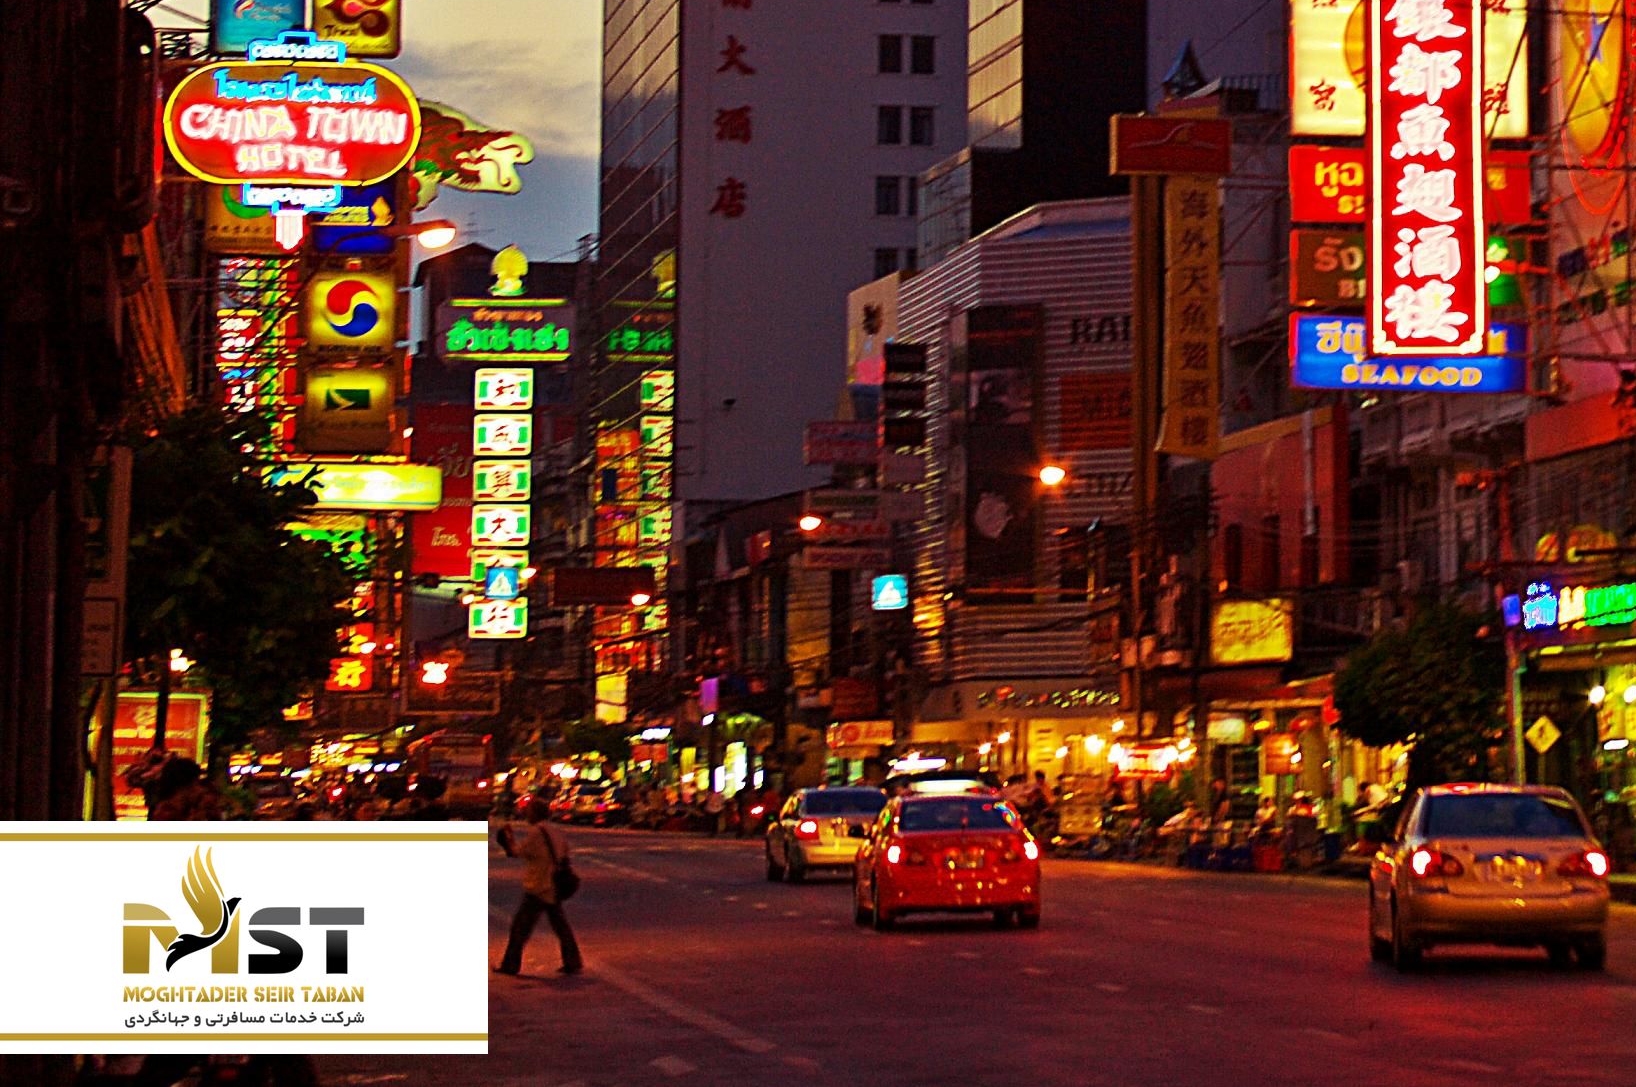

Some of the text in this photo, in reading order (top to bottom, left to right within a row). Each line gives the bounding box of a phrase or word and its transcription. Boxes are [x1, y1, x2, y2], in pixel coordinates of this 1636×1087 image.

[179, 103, 408, 145] CHINA TOWN
[1341, 364, 1483, 387] SEAFOOD
